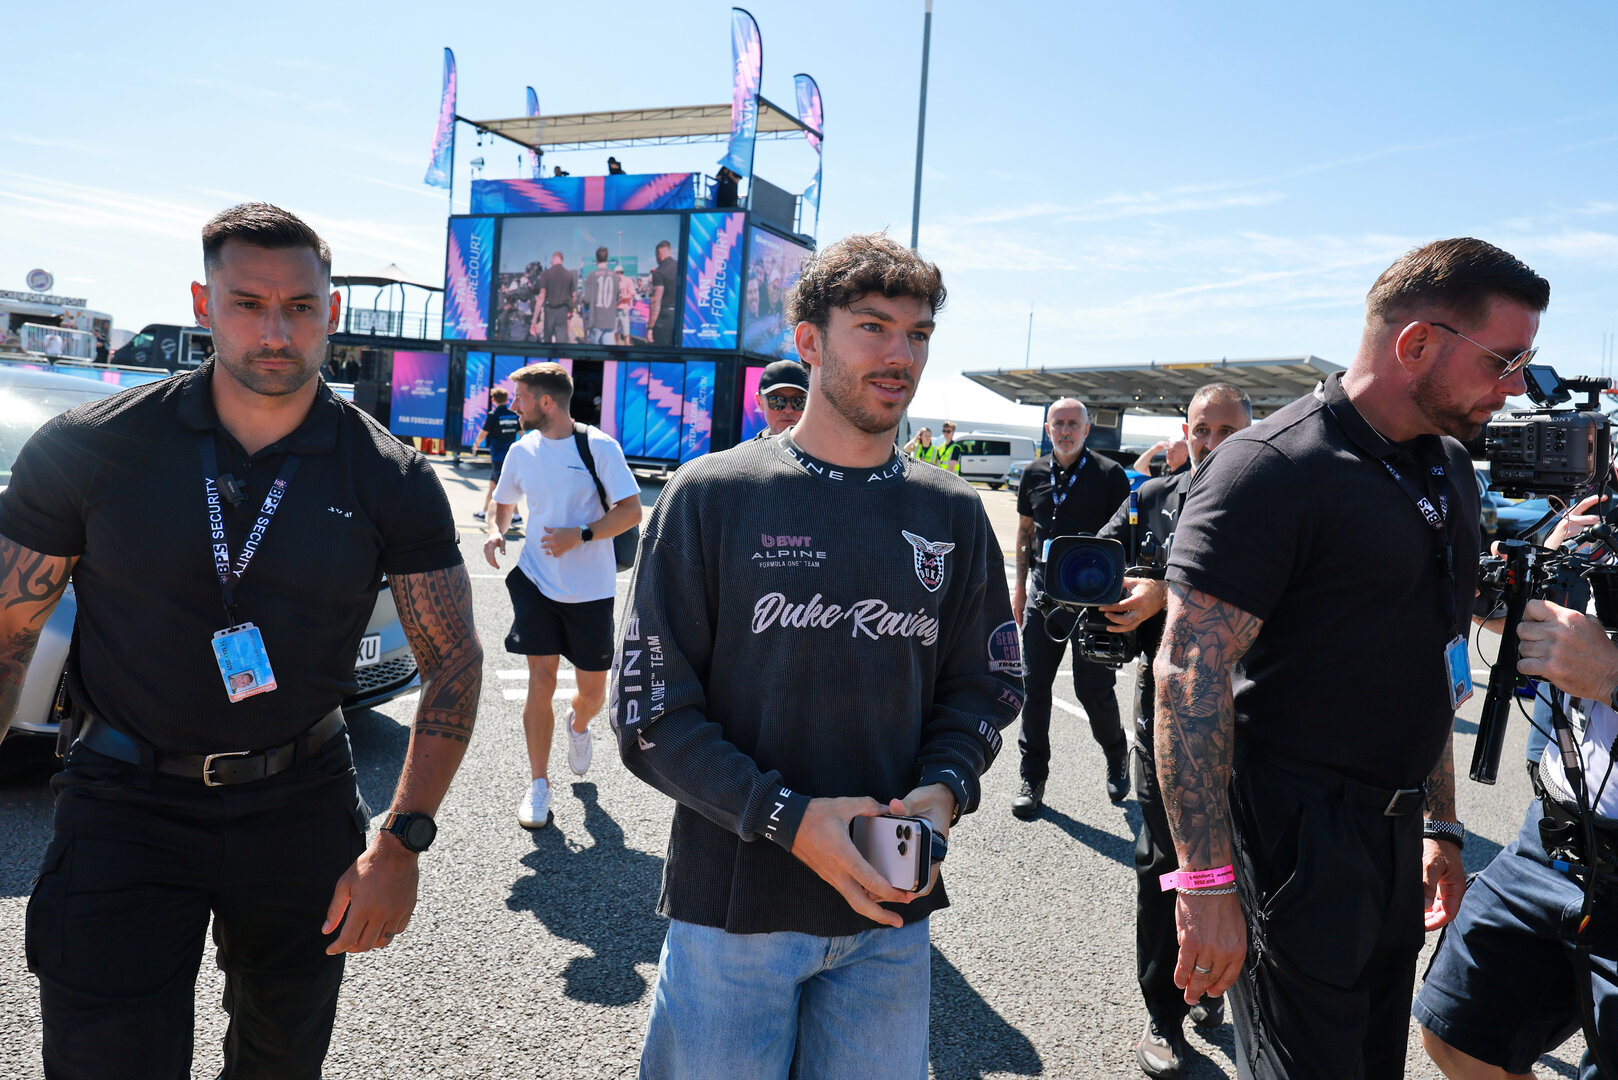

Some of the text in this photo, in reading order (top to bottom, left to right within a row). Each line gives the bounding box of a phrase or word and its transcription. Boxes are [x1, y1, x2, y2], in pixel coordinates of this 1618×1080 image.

[467, 232, 481, 312] FORECOURT
[711, 229, 729, 317] FORECOURT
[456, 277, 467, 303] FAN
[596, 275, 614, 309] 10
[698, 278, 711, 307] FAN
[205, 477, 229, 575] BPS SECURITY
[1417, 498, 1440, 524] BPS
[233, 486, 284, 578] BPS SECURITY
[776, 535, 812, 547] BWT
[751, 550, 827, 559] ALPINE
[920, 567, 941, 583] DUKE
[752, 592, 939, 646] Duke Racing
[647, 635, 664, 667] TEAM
